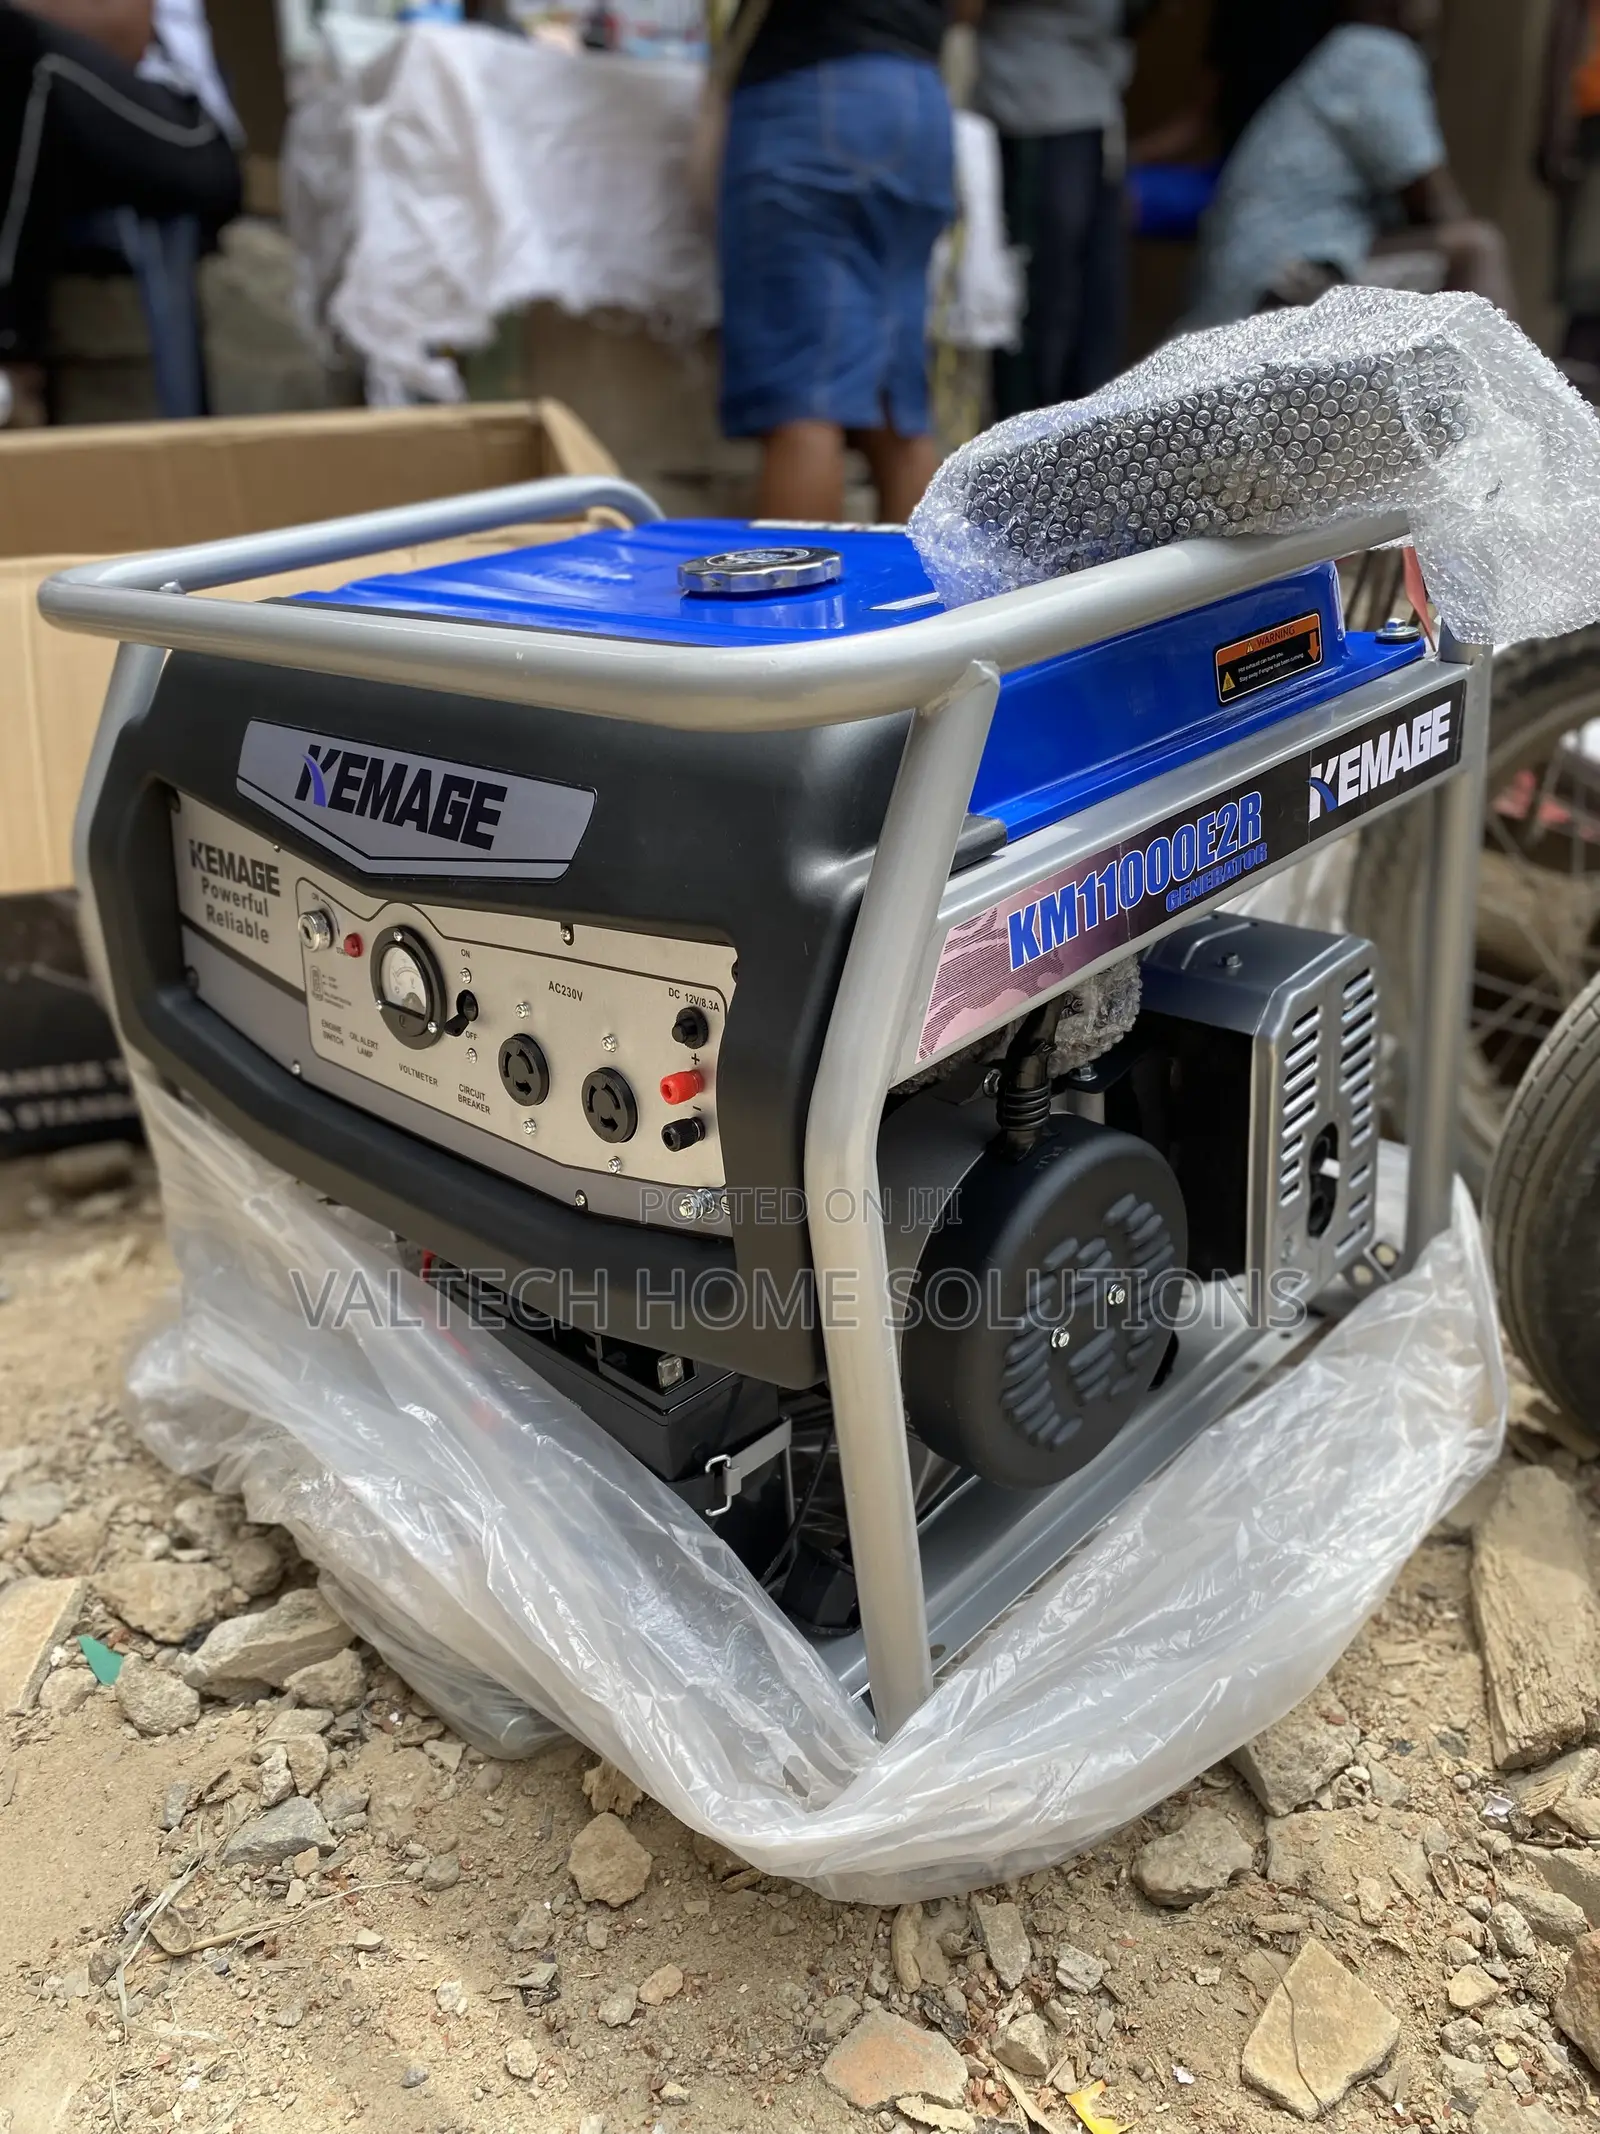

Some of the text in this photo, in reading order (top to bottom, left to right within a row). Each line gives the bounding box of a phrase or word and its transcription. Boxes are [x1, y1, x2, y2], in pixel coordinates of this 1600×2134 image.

[1257, 625, 1295, 647] WARNING
[1306, 700, 1452, 824] KEMAGE
[294, 743, 508, 851] KEMAGE
[188, 838, 281, 898] KEMAGE
[1165, 841, 1269, 914] GENERATOR
[1007, 790, 1263, 972] KM11000E2R
[202, 875, 269, 918] Powerful
[206, 903, 270, 944] Reliable
[461, 948, 471, 958] ON
[548, 980, 583, 1002] AC230V
[668, 987, 720, 1012] DC 12V/8.3A
[321, 1019, 342, 1035] ENGINE
[465, 1030, 478, 1041] OFF
[323, 1030, 345, 1047] SWITCH
[349, 1031, 379, 1050] OIL ALERT
[357, 1046, 374, 1059] LAMP
[398, 1063, 439, 1087] VOLTMETER
[458, 1083, 486, 1102] CIRCUIT
[457, 1093, 491, 1115] BREAKER
